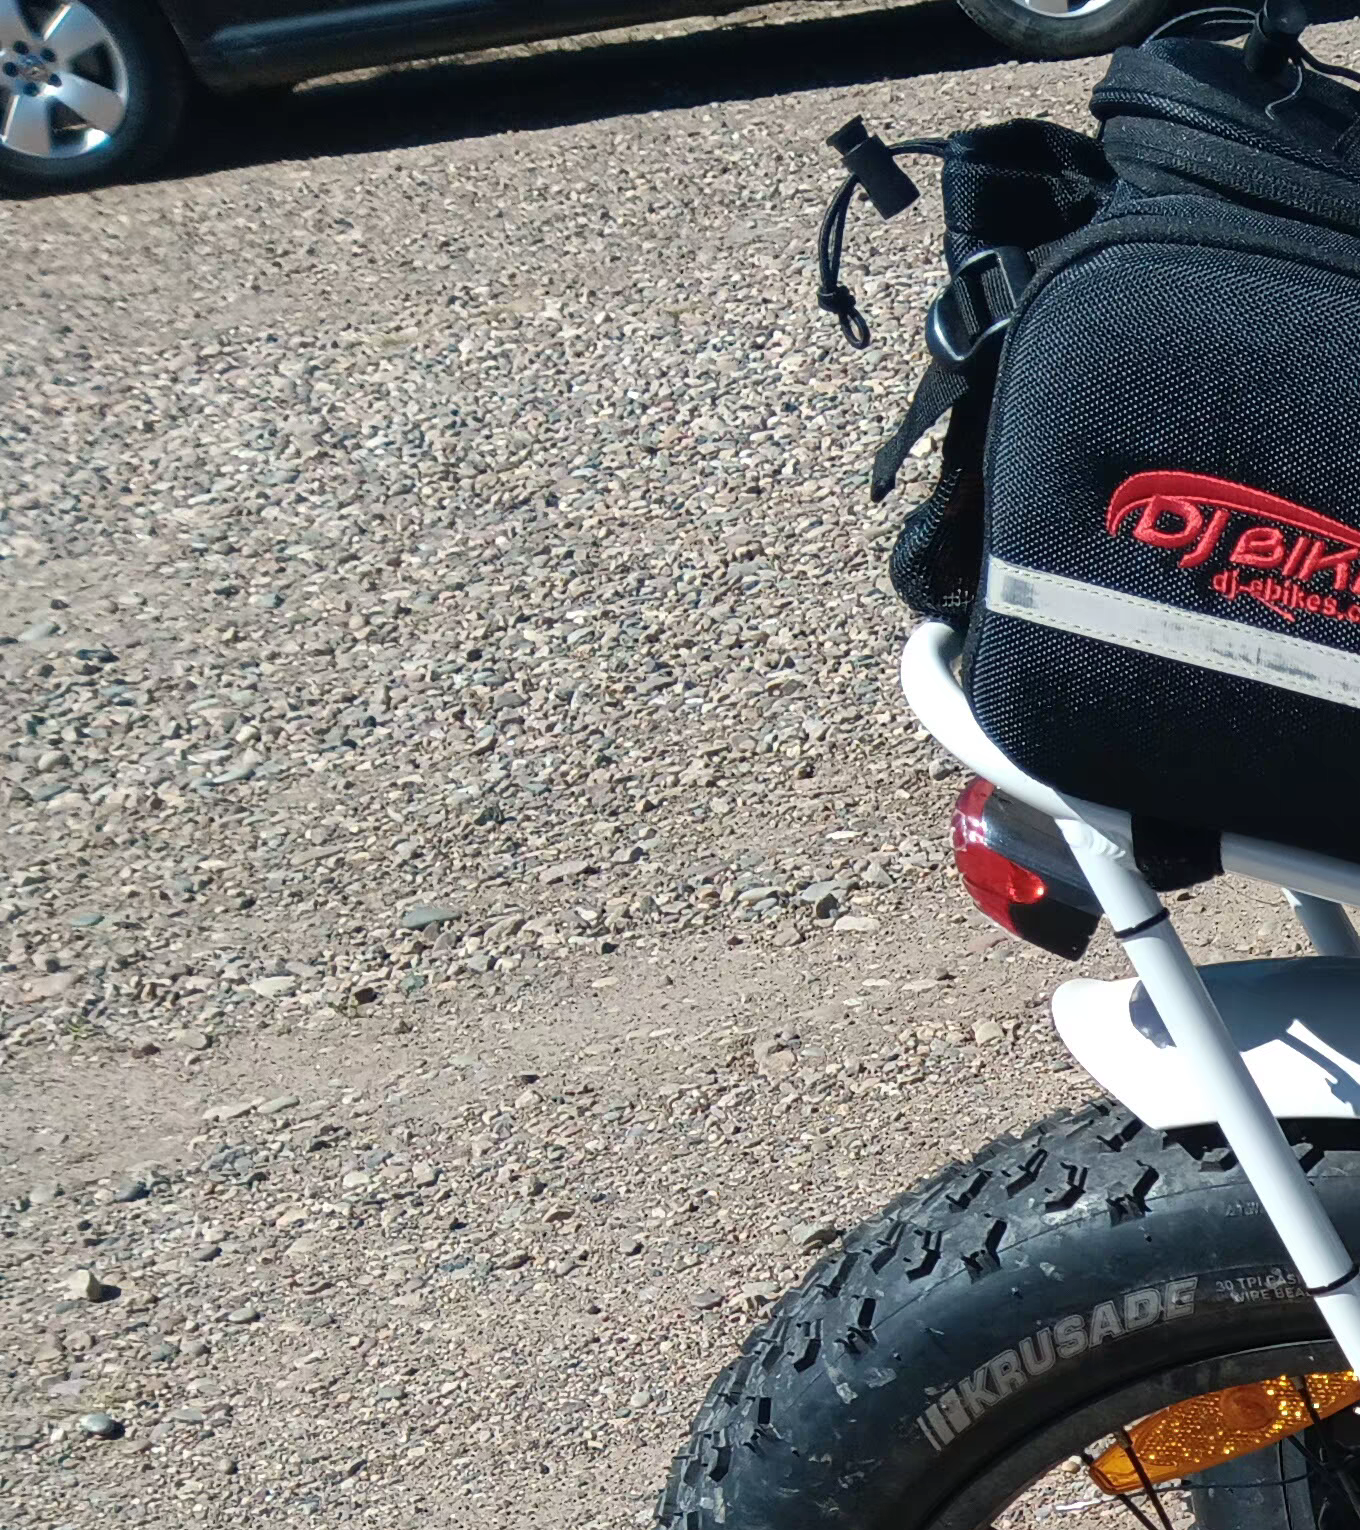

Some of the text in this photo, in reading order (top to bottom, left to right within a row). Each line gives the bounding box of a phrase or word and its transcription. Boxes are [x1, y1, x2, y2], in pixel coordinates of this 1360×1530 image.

[1133, 495, 1230, 569] DJ
[1237, 1275, 1262, 1289] TPI
[966, 1276, 1199, 1416] KRUSADE
